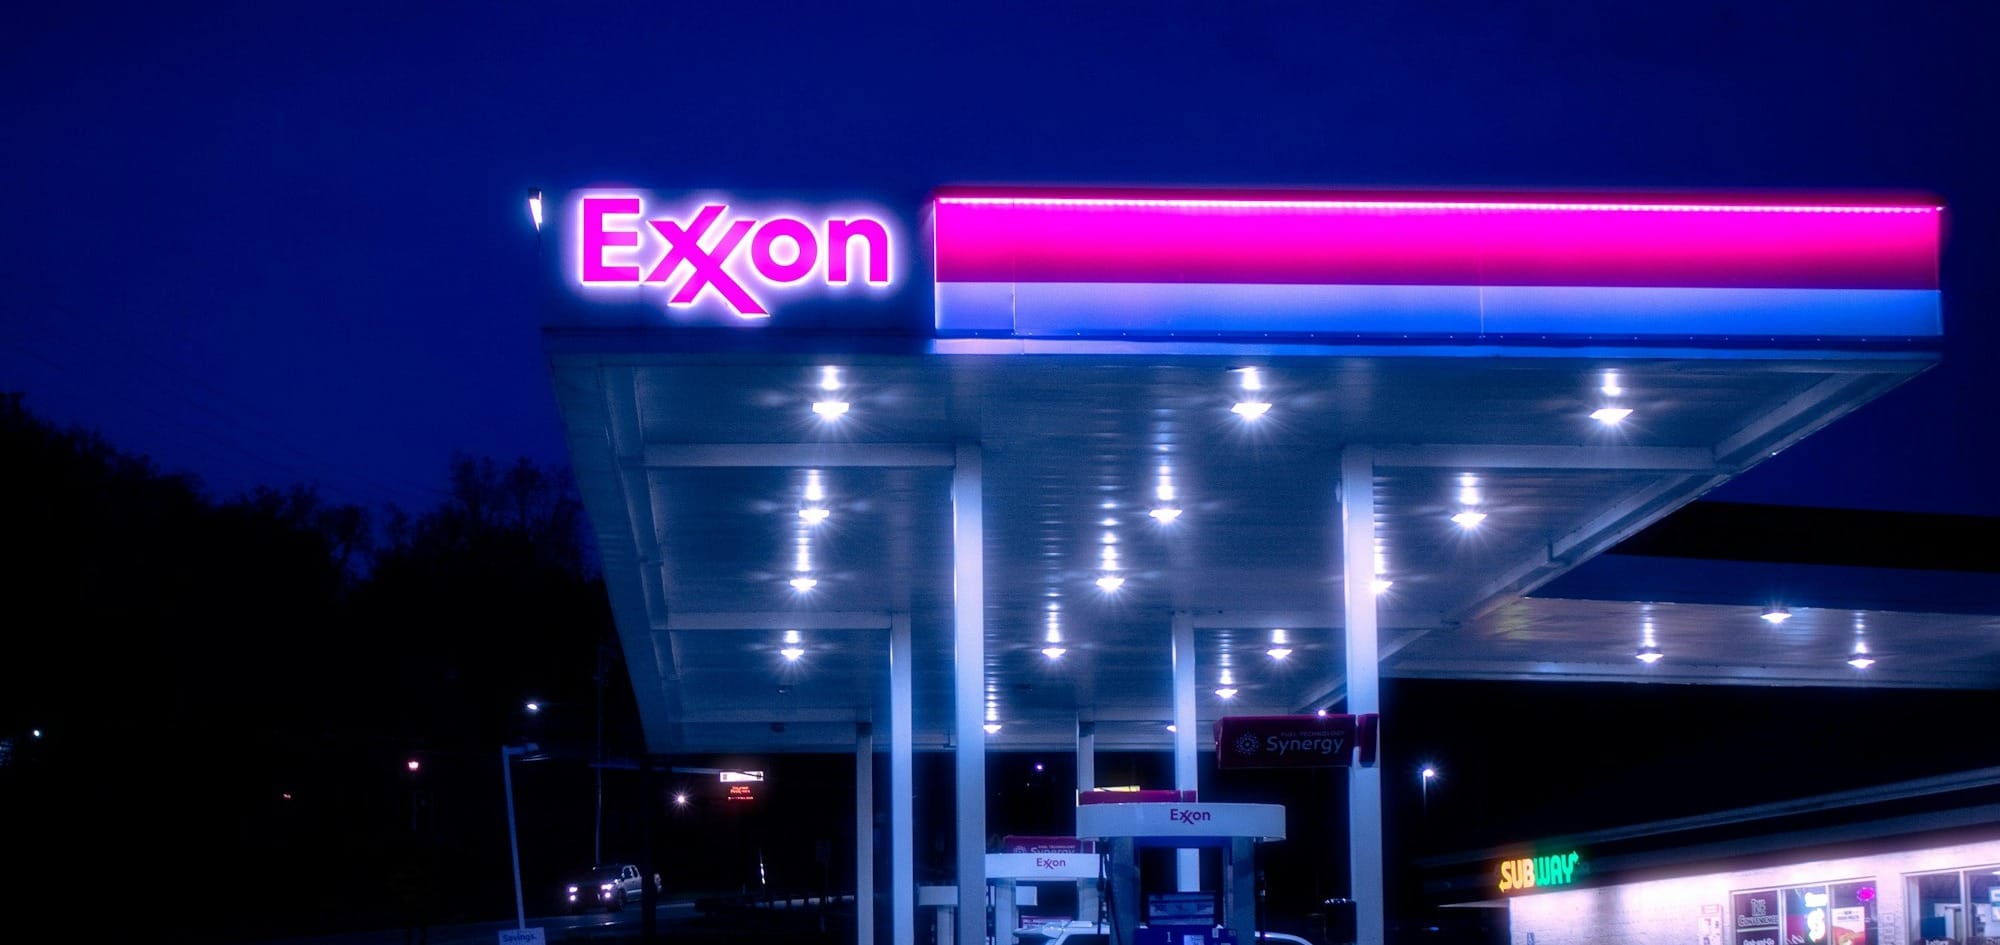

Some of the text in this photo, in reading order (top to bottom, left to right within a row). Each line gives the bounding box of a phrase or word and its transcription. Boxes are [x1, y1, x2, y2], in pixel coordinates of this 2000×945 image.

[582, 197, 890, 315] Exxon
[1266, 736, 1344, 755] Synergy
[1169, 808, 1211, 825] Exxon
[1036, 858, 1066, 870] Exxon
[1499, 851, 1579, 893] SUBWAY
